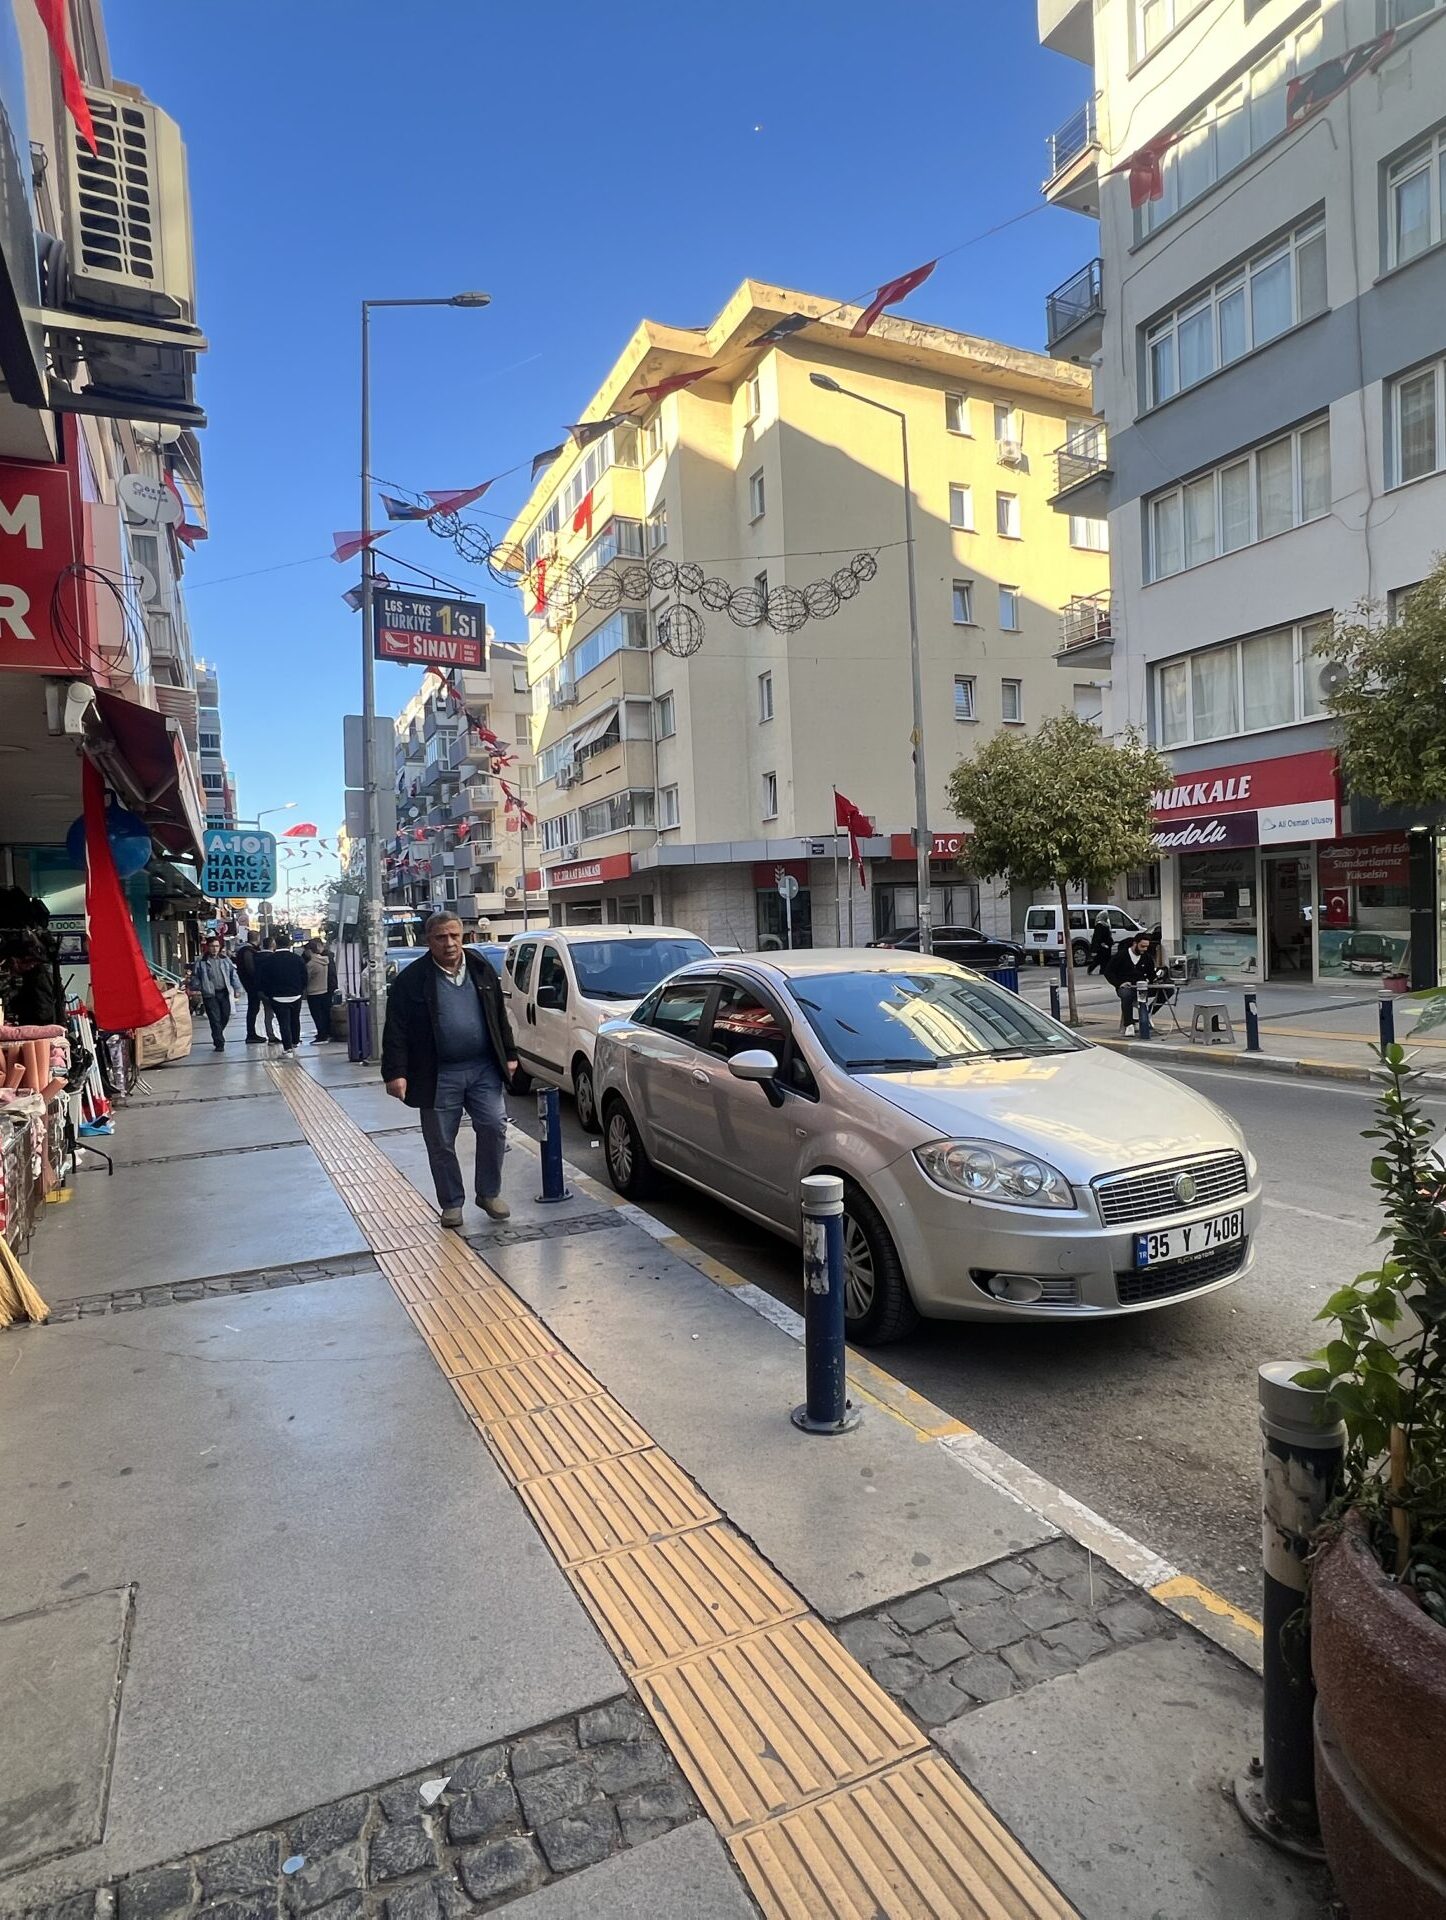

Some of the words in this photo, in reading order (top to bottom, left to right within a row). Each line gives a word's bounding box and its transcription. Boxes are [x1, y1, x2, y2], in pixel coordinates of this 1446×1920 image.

[384, 600, 403, 613] LGS
[412, 603, 432, 616] YKS
[1310, 816, 1333, 825] Ulusoy
[207, 854, 270, 867] HARCA
[207, 867, 271, 880] HARCA
[1148, 1234, 1170, 1260] 35
[1183, 1228, 1192, 1252] Y
[1203, 1213, 1239, 1246] 7408
